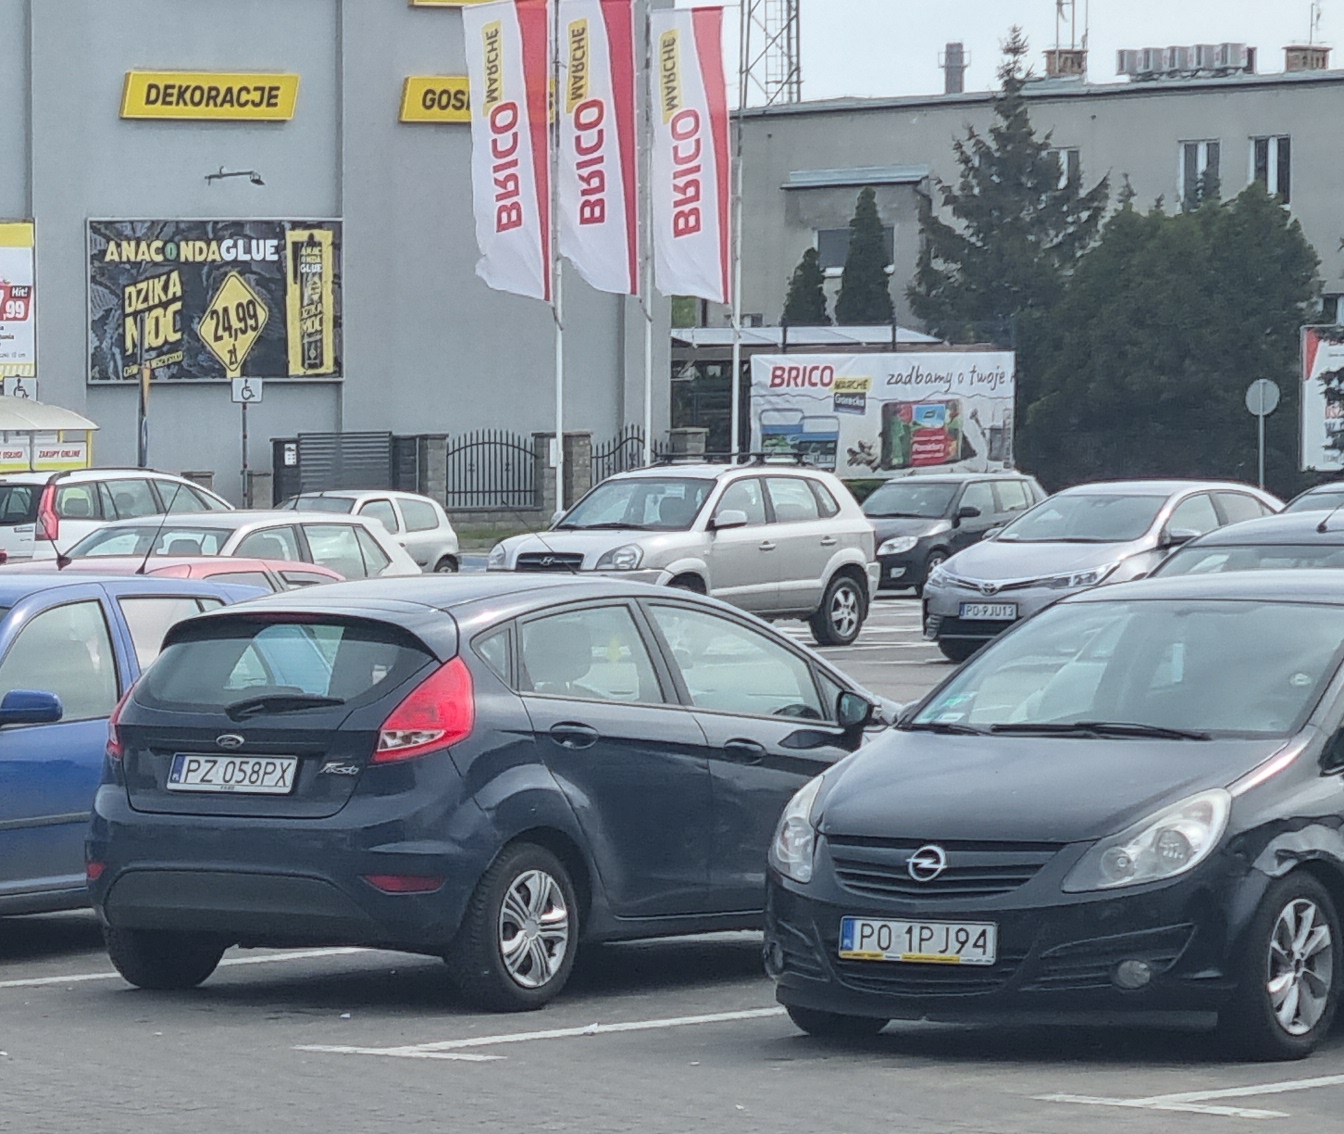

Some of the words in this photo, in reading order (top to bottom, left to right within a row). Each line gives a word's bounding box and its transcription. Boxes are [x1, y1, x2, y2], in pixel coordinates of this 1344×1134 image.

[144, 83, 281, 109] DEKORACJE
[300, 263, 323, 273] GLUE
[11, 286, 28, 298] Hit!
[124, 269, 182, 314] DZIKA
[124, 301, 183, 356] MOC
[211, 299, 259, 343] 24,99
[769, 365, 834, 388] BRICO
[886, 365, 952, 393] zadbamy
[957, 375, 964, 384] o
[969, 365, 1005, 391] twoje
[966, 605, 979, 616] PO
[982, 605, 1014, 617] 9JU13
[184, 759, 218, 783] PZ
[223, 761, 292, 787] 058PX
[859, 923, 892, 951] PO
[904, 925, 987, 956] 1PJ94
